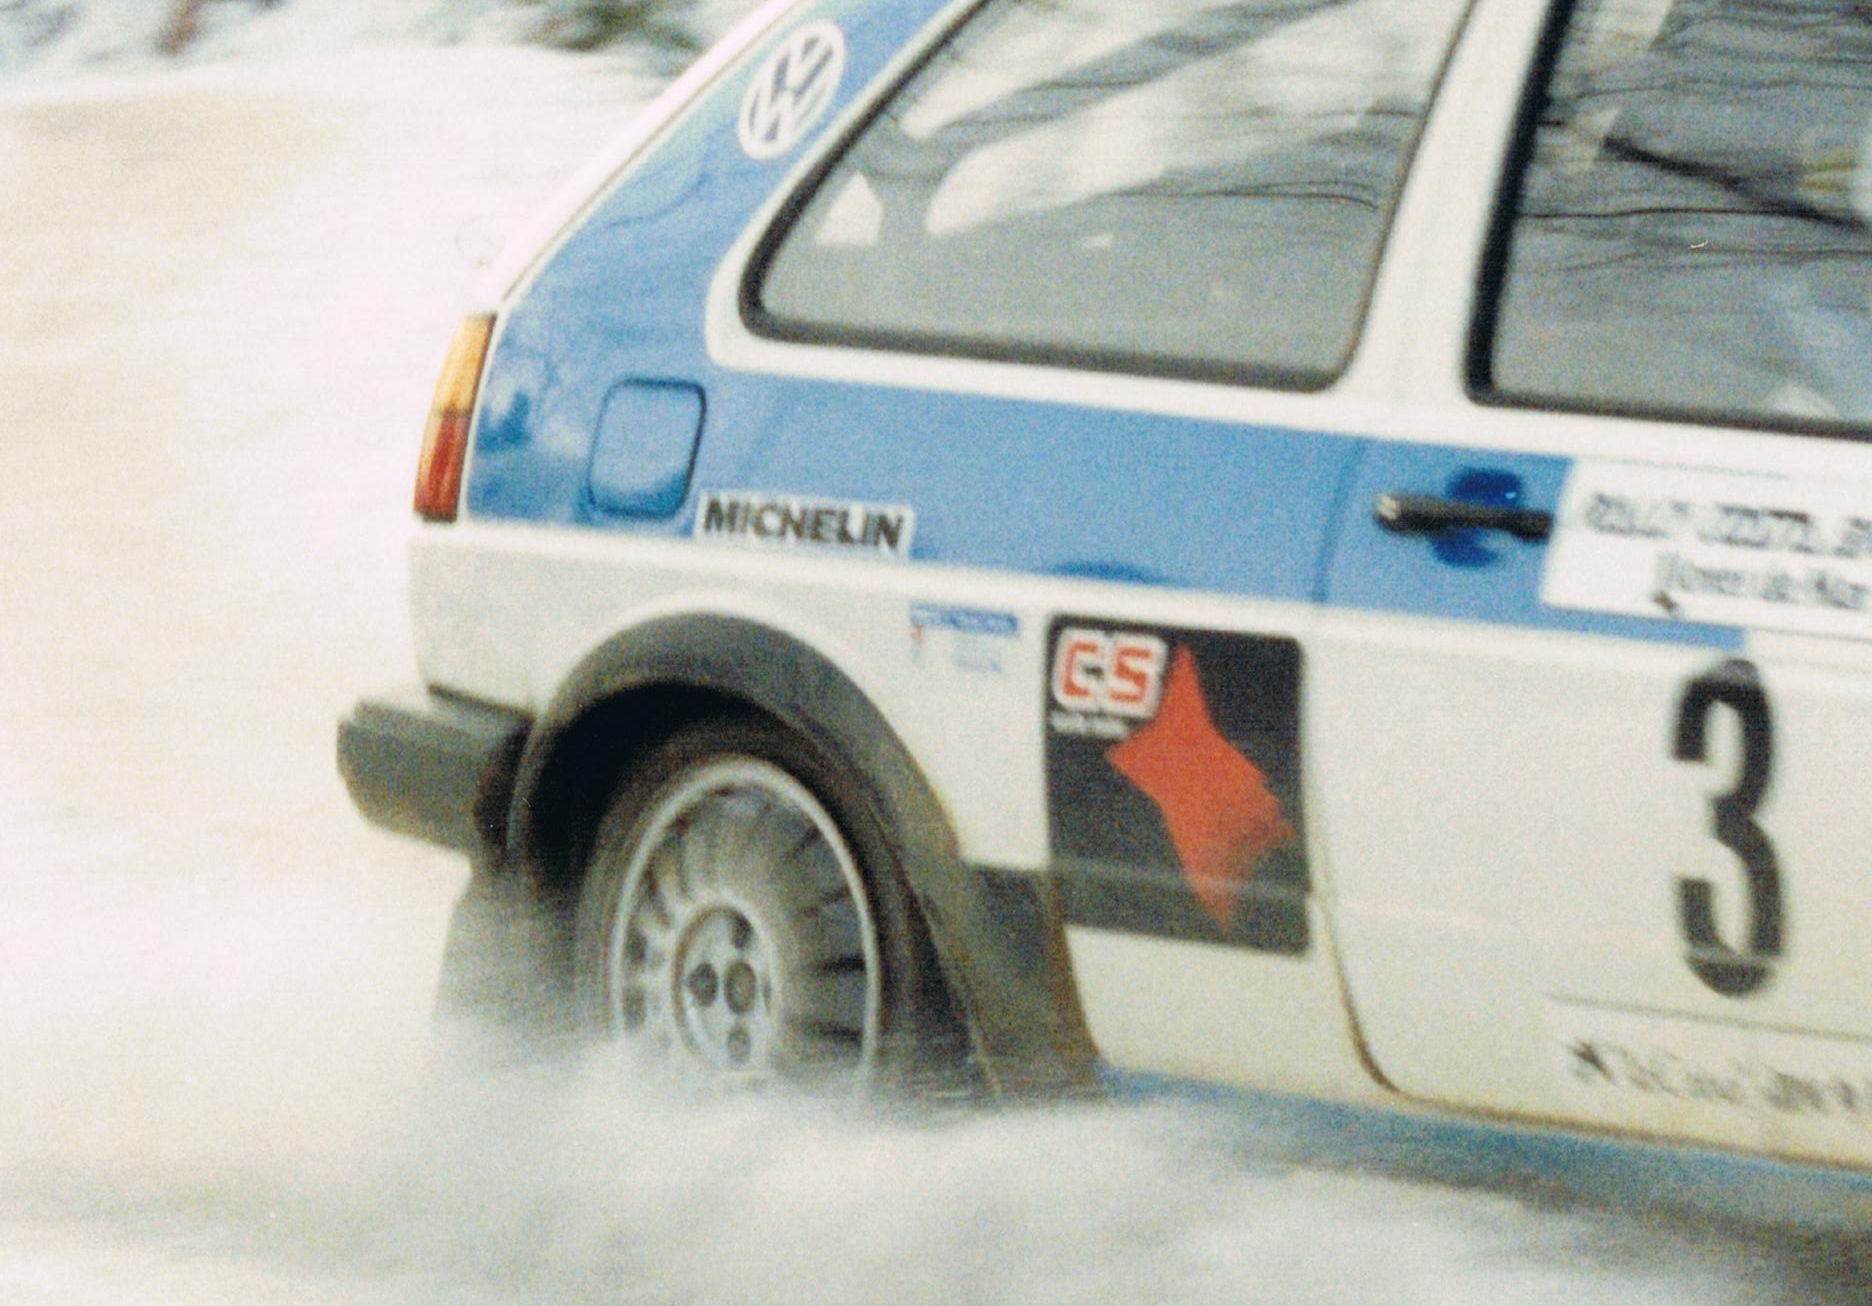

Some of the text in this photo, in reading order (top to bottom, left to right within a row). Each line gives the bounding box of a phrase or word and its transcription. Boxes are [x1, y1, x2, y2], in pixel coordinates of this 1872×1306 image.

[739, 21, 846, 160] VW
[702, 497, 905, 552] MICHELIN
[1670, 658, 1785, 998] 3
